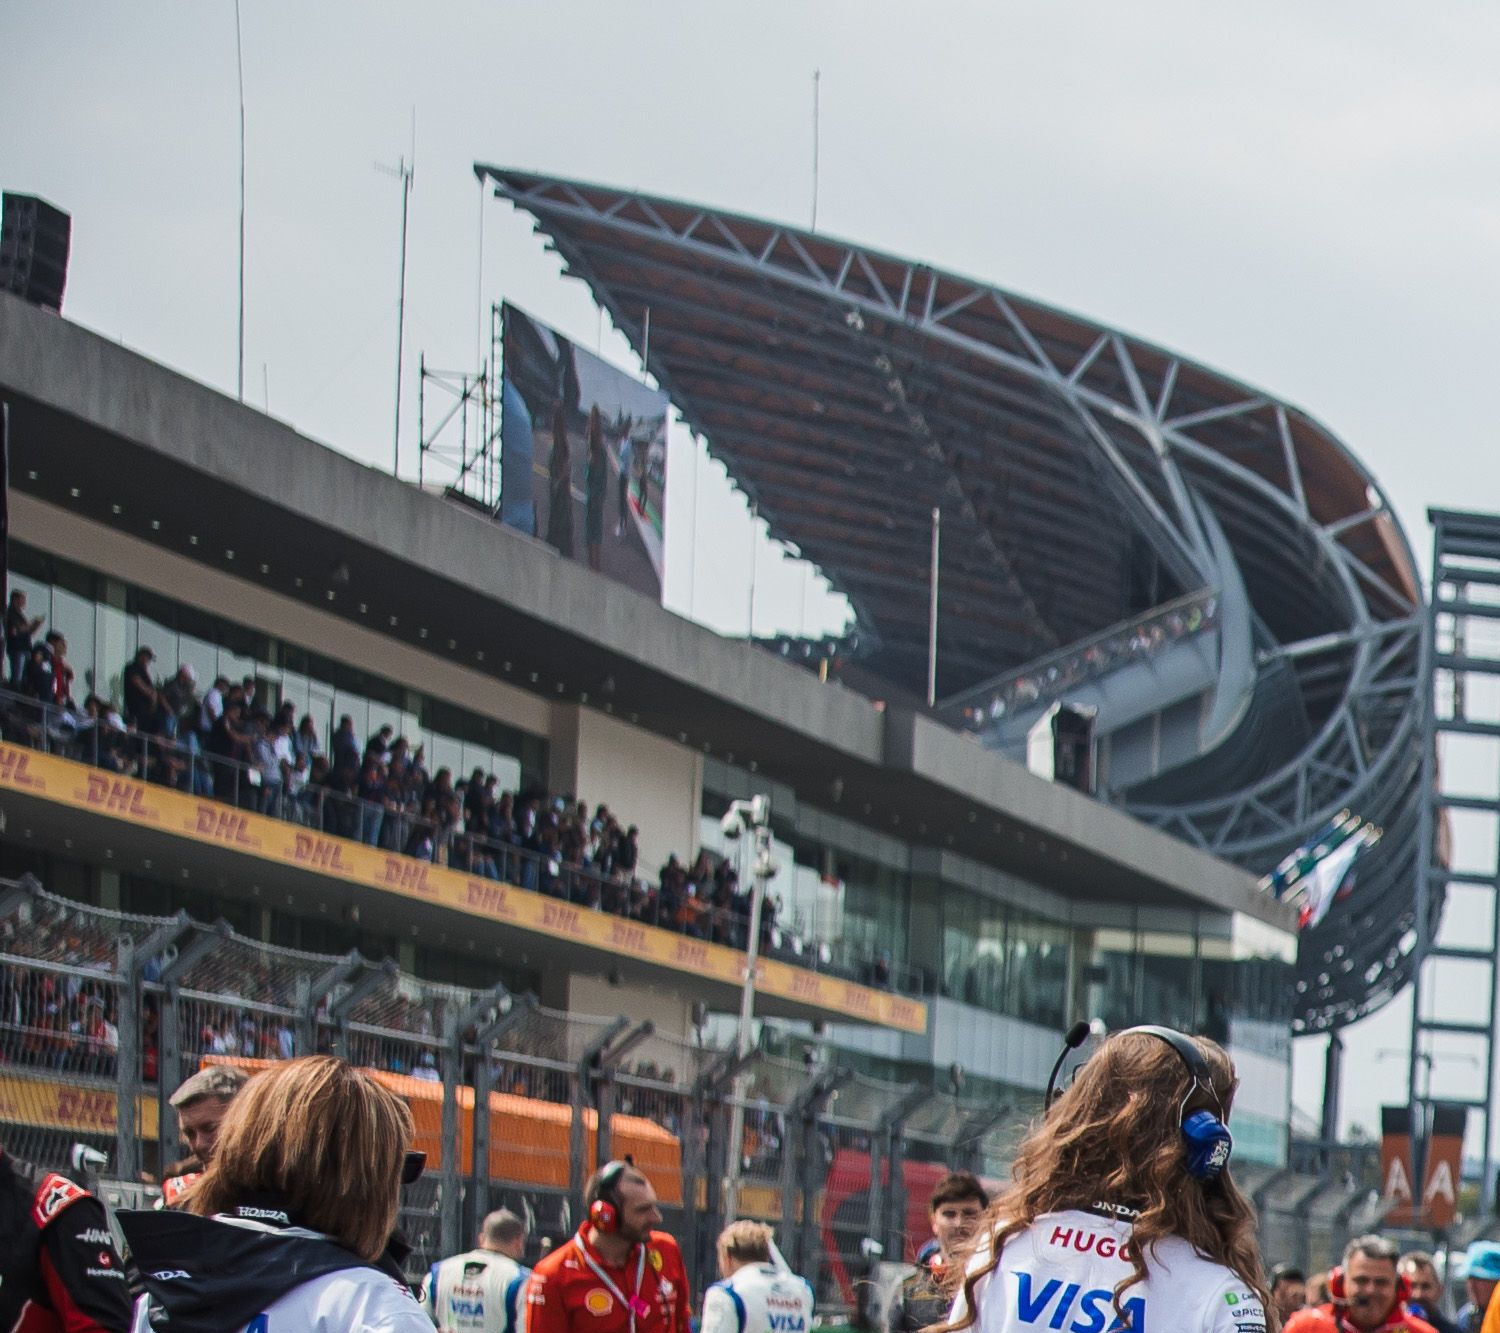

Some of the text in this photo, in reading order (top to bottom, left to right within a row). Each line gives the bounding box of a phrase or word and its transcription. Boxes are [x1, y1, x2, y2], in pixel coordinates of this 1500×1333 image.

[84, 773, 149, 816] DHL
[196, 803, 250, 845] DHL
[294, 831, 345, 870] DHL
